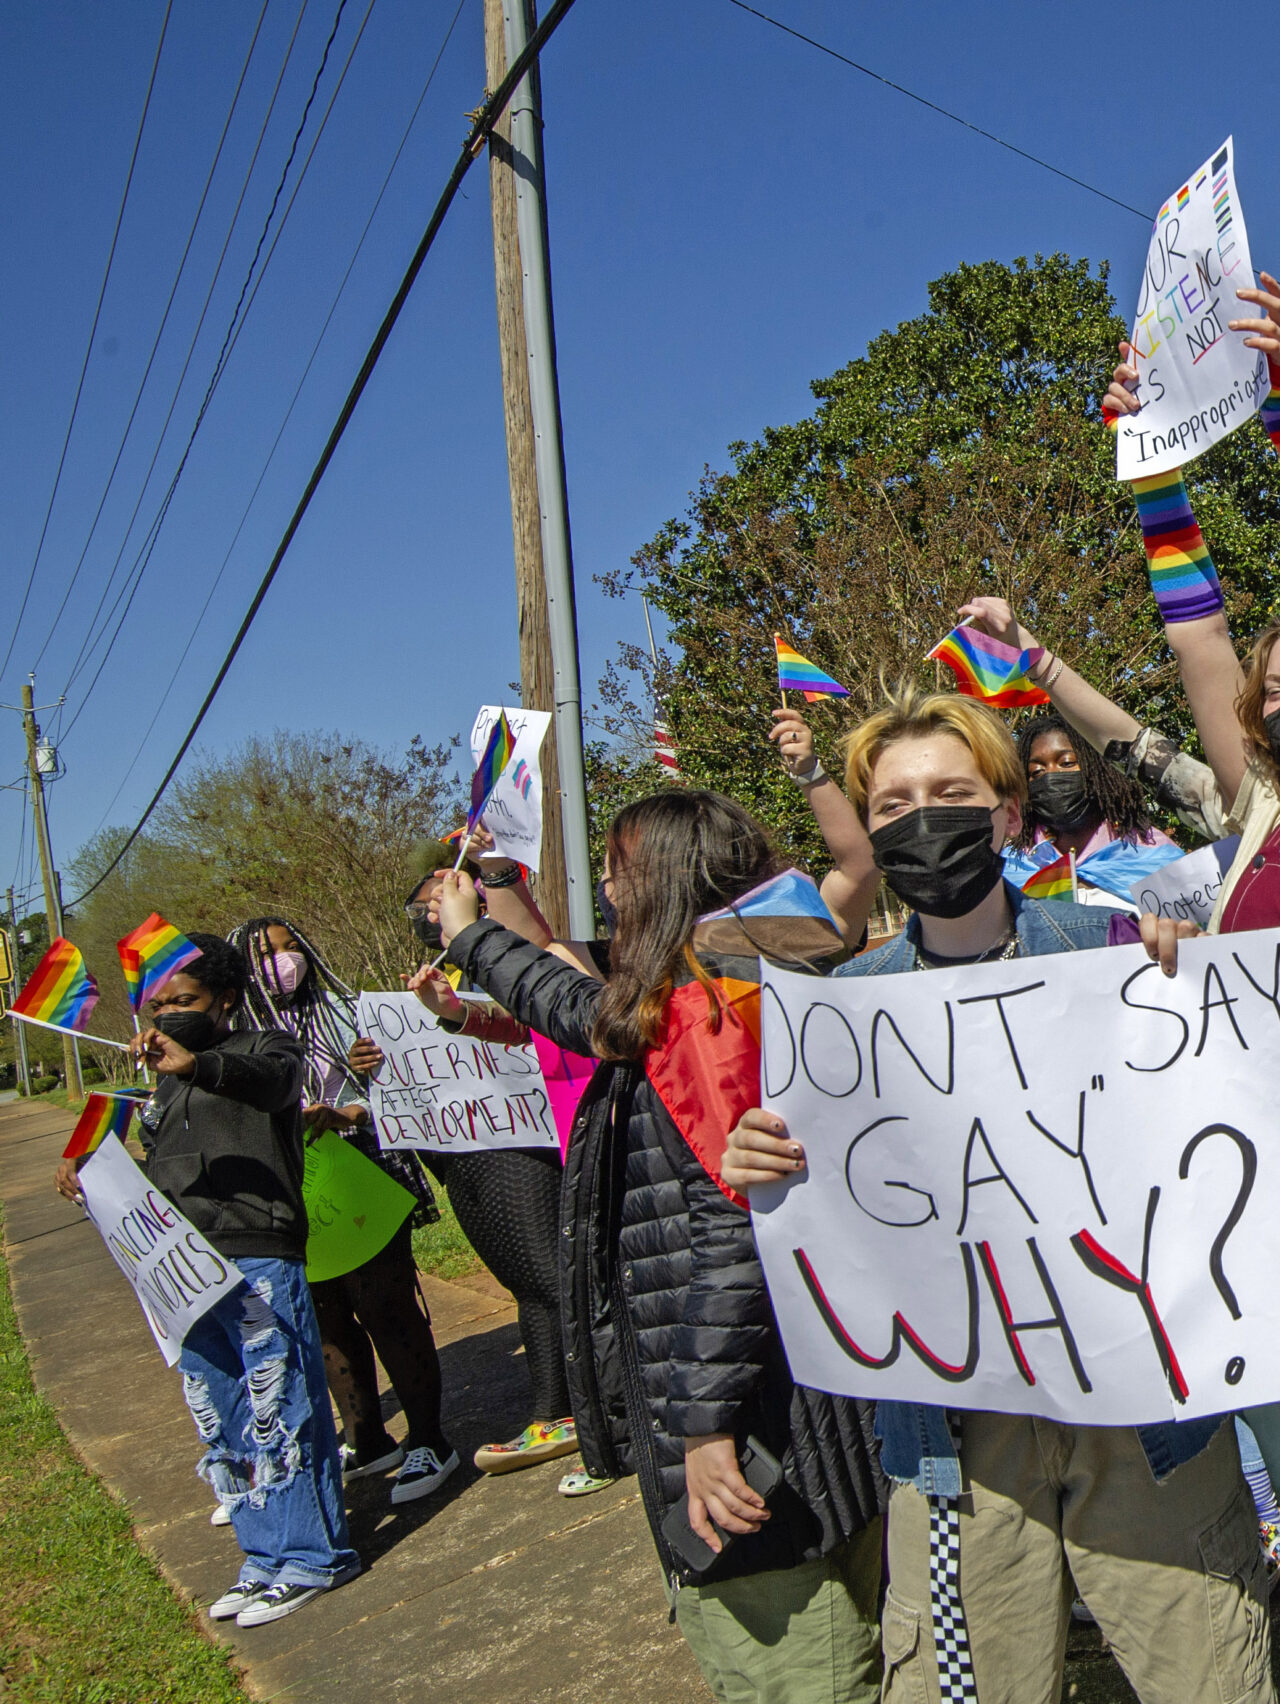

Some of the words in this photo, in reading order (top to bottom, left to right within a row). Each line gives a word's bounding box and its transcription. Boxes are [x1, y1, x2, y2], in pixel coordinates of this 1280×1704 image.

[1129, 228, 1241, 370] XISTENCE
[1130, 368, 1165, 412] IS
[1186, 297, 1224, 362] NOT
[370, 1041, 542, 1087] QUEERNESS
[761, 981, 1046, 1099] DONT
[379, 1088, 554, 1145] DEVELOPMENT?
[380, 1084, 441, 1115] AFFECT
[143, 1232, 229, 1316] VOICES
[793, 1123, 1258, 1405] WHY?
